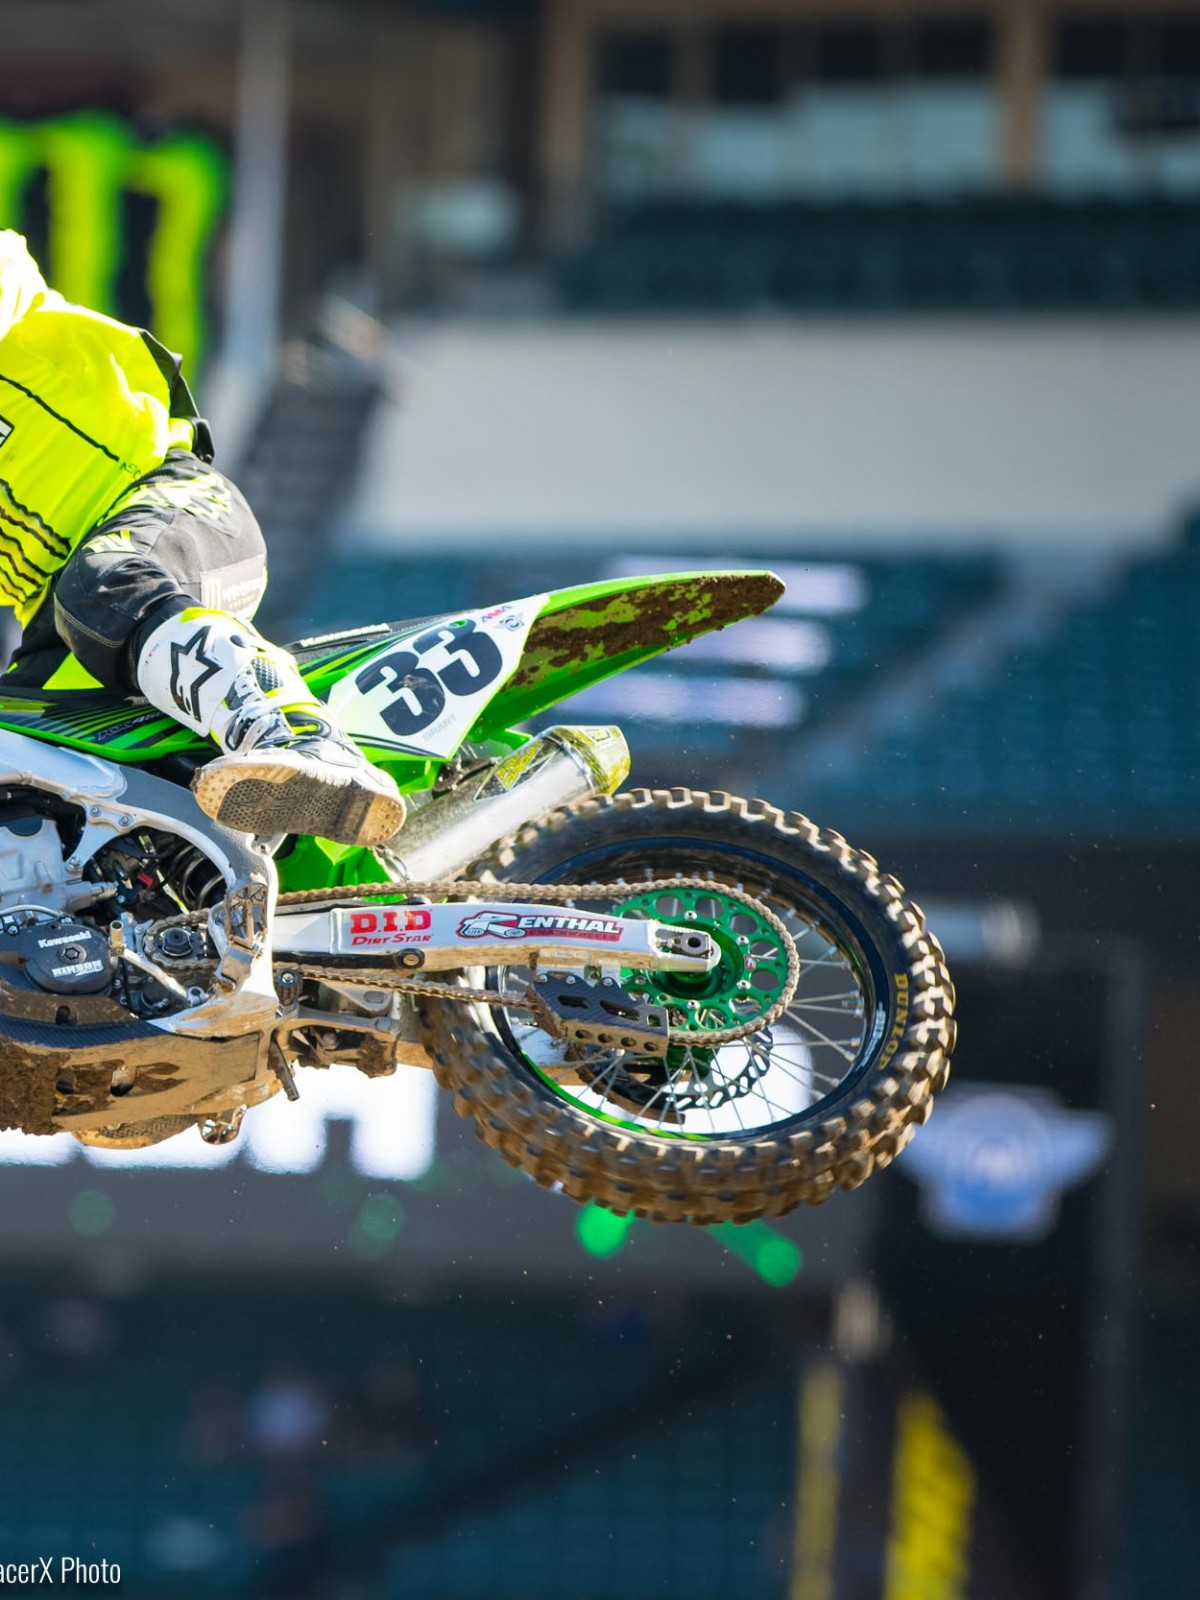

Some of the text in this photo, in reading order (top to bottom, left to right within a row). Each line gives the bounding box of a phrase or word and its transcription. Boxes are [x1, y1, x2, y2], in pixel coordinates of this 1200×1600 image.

[355, 618, 503, 737] 33
[423, 714, 456, 742] GRANT
[351, 910, 432, 934] D.I.D
[879, 972, 909, 1072] DUNLOP
